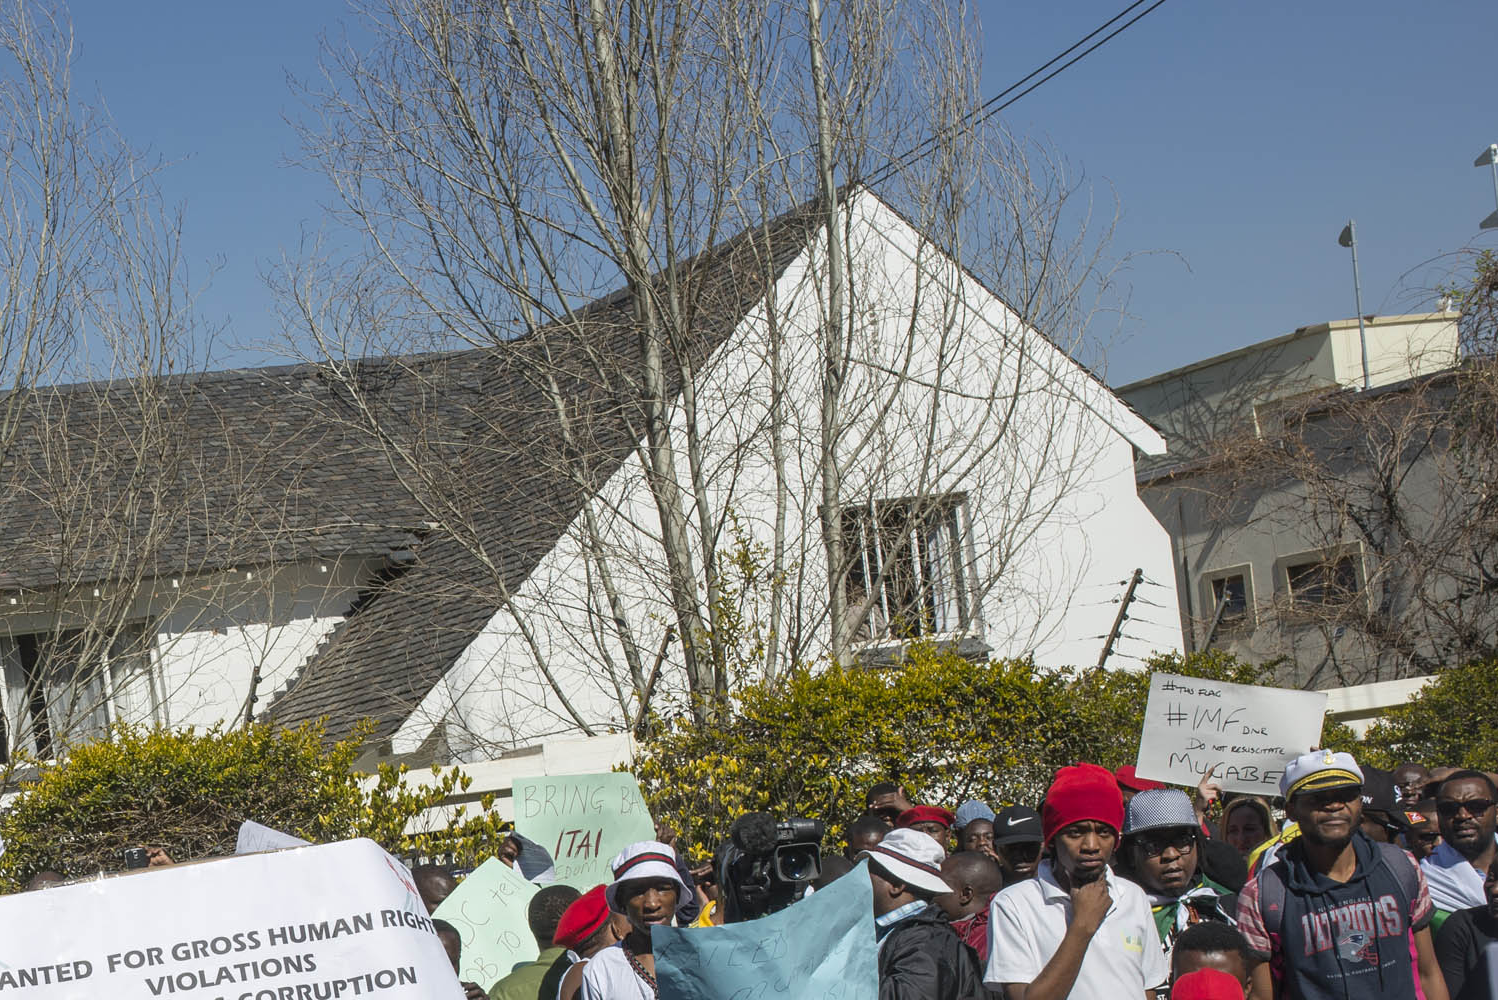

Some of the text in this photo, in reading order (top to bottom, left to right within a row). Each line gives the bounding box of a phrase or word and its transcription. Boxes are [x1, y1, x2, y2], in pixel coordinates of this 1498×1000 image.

[1169, 752, 1287, 784] MUGABE
[524, 784, 606, 818] BRING
[555, 827, 603, 860] ITAI
[107, 947, 164, 973] FOR
[171, 931, 261, 961] GROSS
[268, 913, 374, 946] HUMAN
[145, 954, 317, 996] VIOLATIONS
